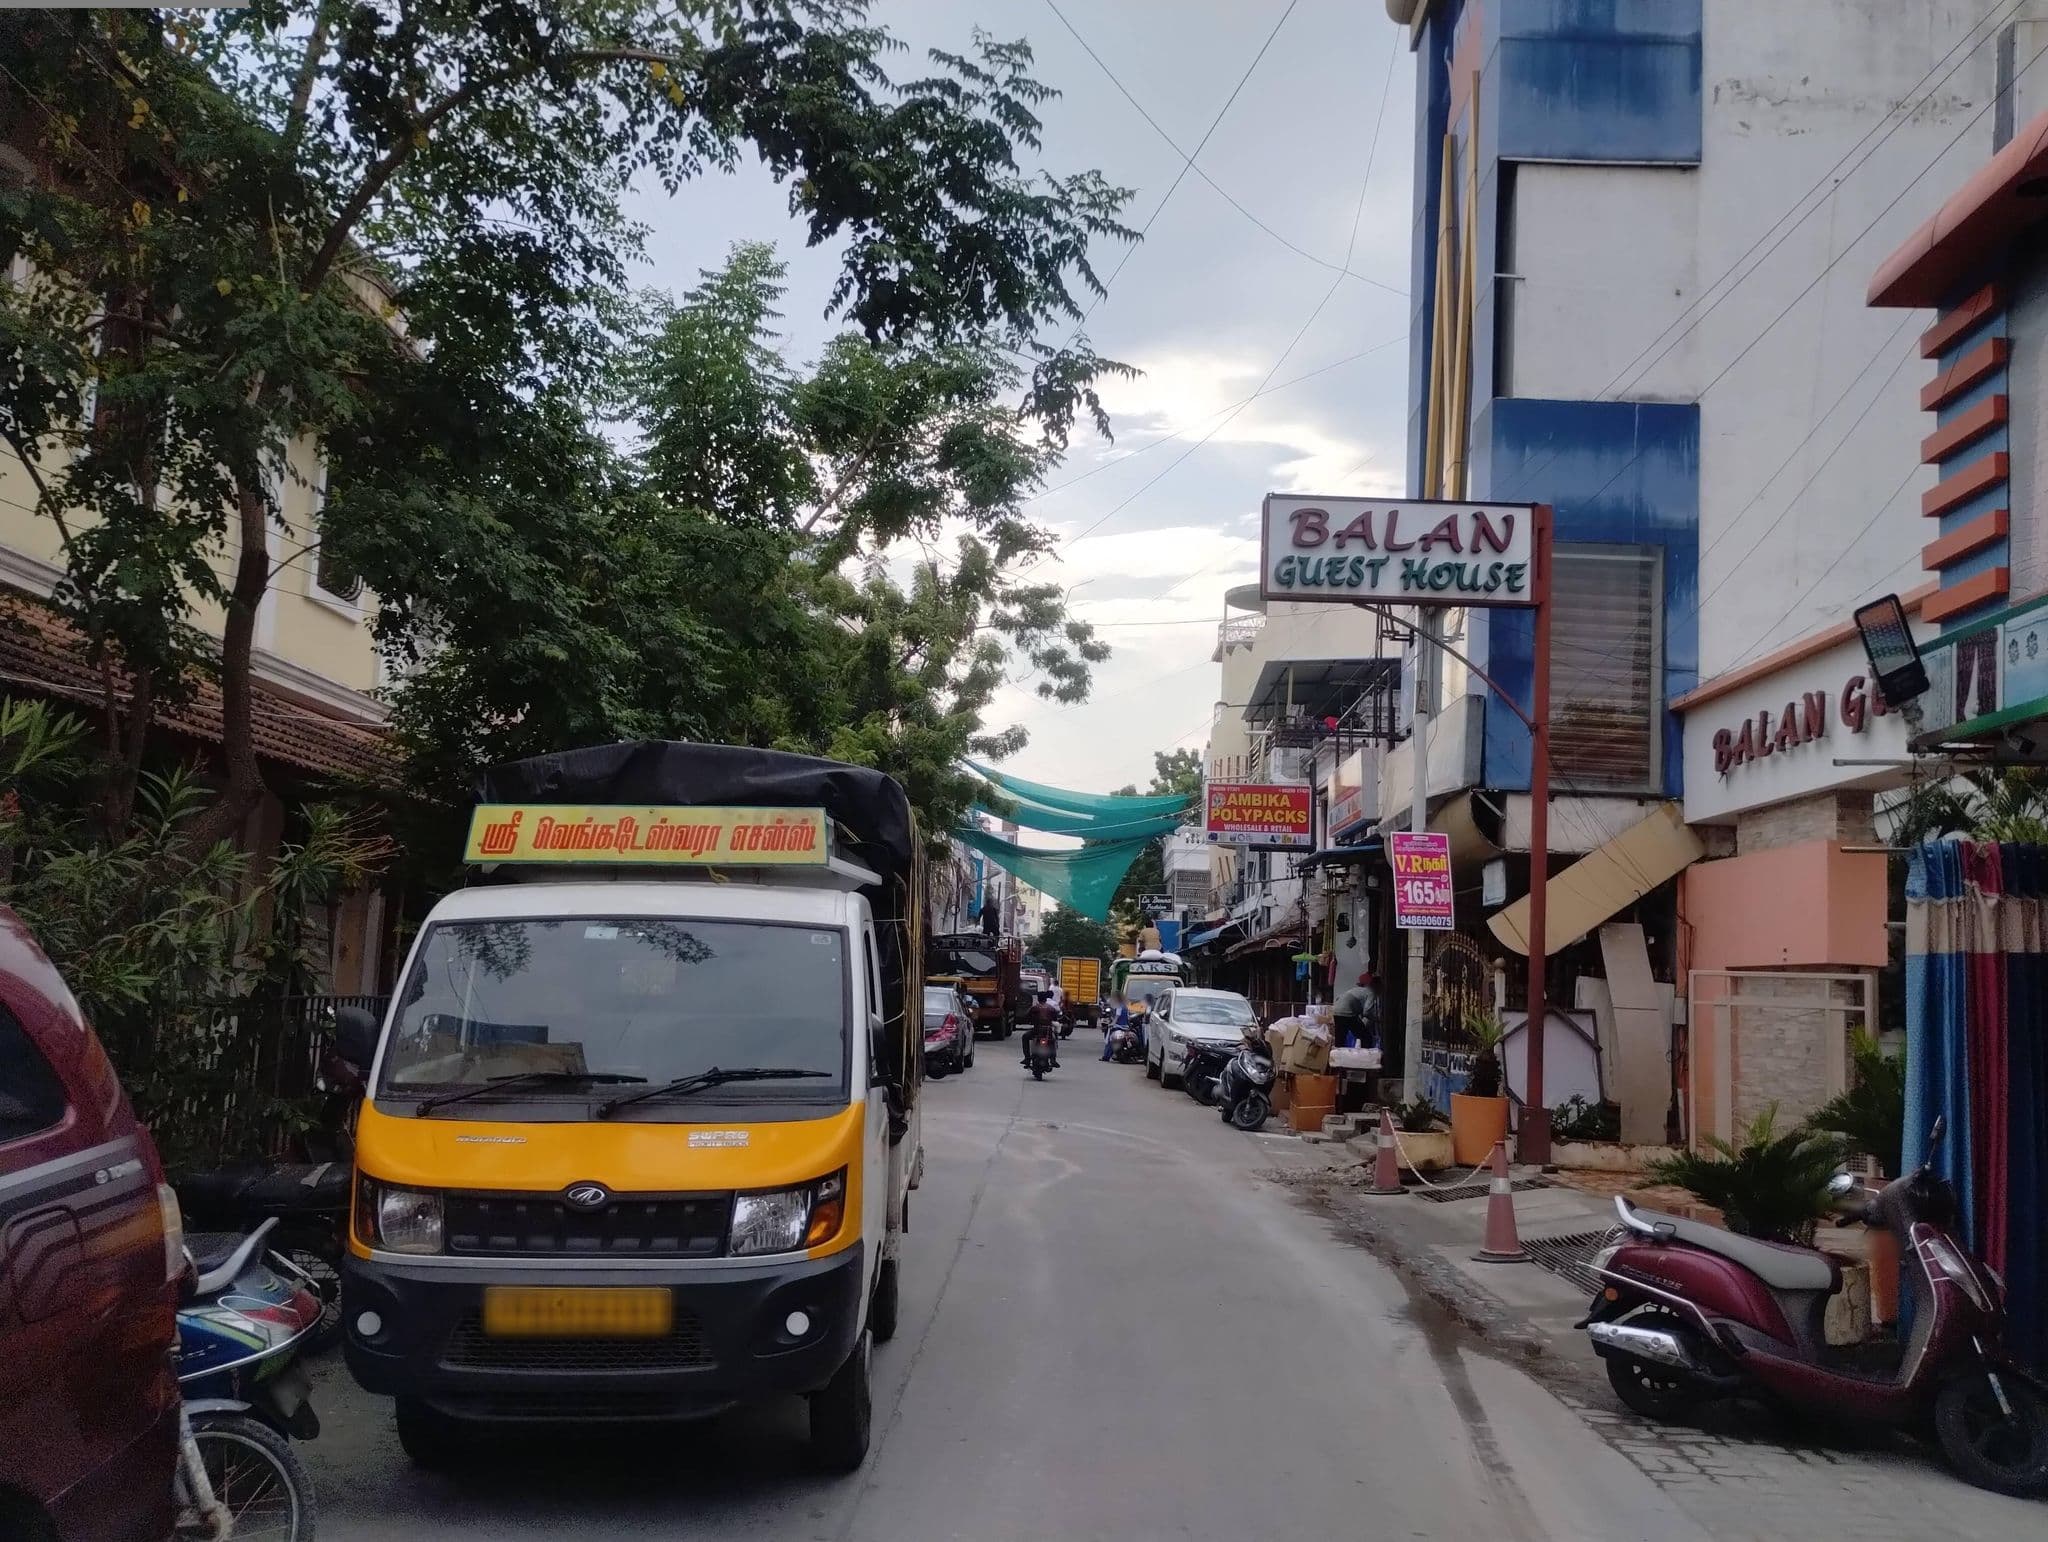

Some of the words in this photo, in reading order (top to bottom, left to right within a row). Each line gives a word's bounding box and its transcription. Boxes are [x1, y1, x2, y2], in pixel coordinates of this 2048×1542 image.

[1289, 507, 1515, 554] BALAN
[1274, 555, 1390, 589] GUEST
[1400, 557, 1528, 593] HOUSE
[1713, 690, 1826, 772] BALAN
[1227, 793, 1291, 807] AMBIKA
[1210, 807, 1307, 824] POLYPACKS
[1224, 823, 1262, 832] WHOLESALE
[1270, 824, 1293, 833] RETAIL
[1400, 914, 1452, 926] 9486906075
